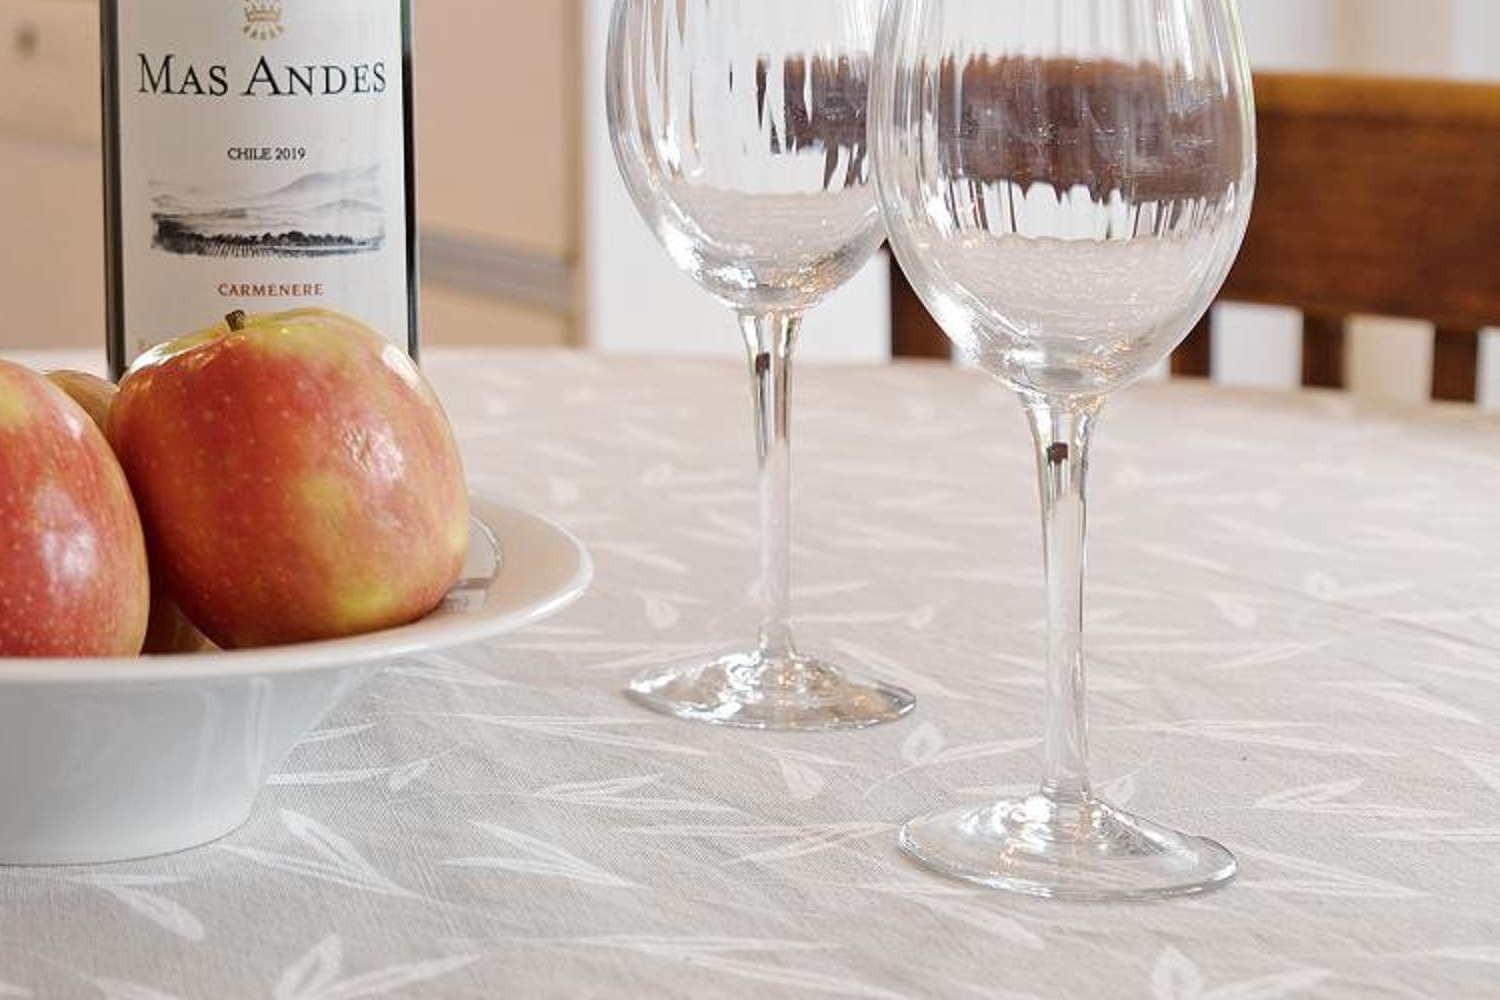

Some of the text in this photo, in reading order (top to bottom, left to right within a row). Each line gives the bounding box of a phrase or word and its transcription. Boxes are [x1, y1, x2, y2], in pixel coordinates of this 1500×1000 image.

[227, 147, 306, 161] CHILE 2019
[218, 283, 324, 297] CARMENERE
